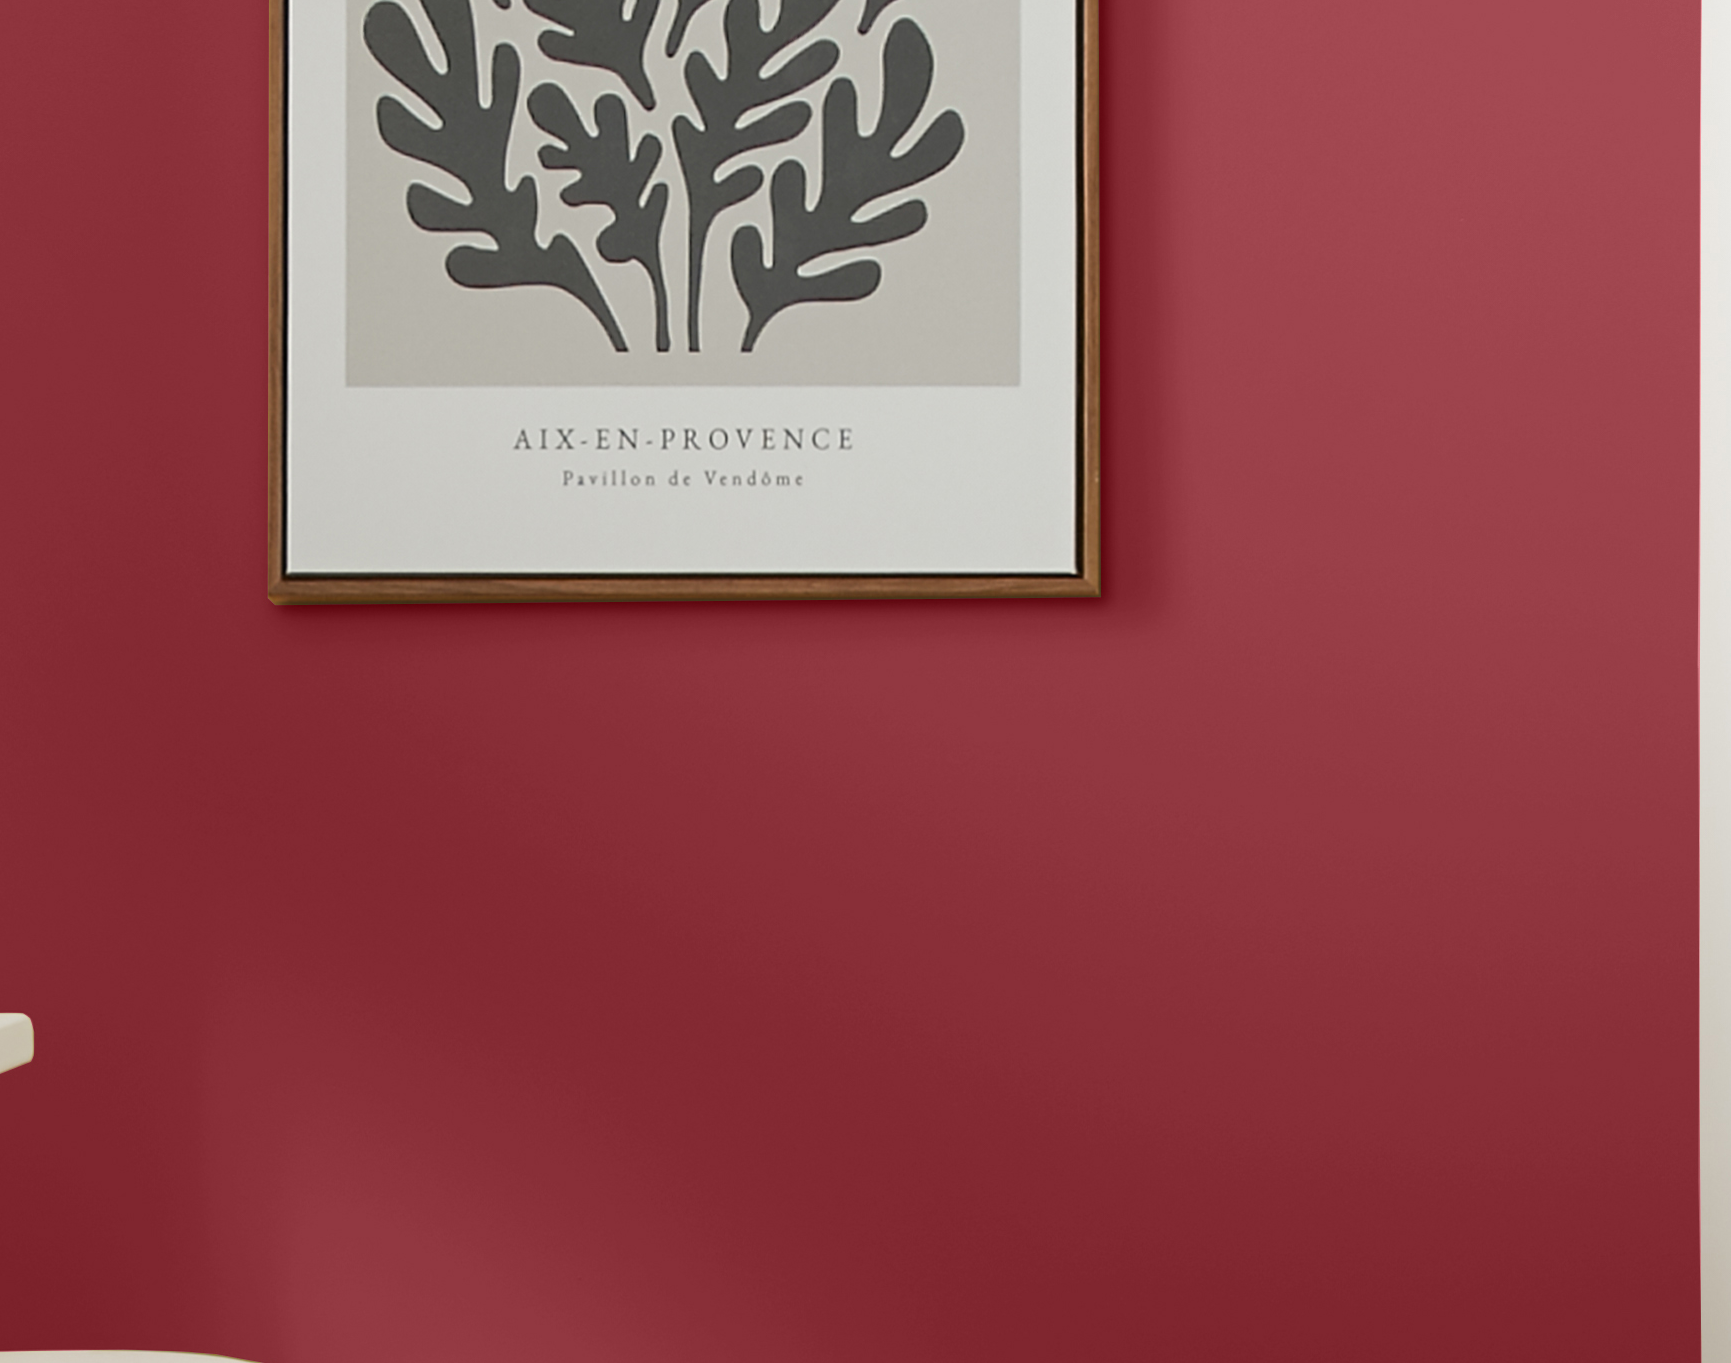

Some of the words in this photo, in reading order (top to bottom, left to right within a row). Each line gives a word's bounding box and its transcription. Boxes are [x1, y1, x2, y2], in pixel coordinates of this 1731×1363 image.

[513, 427, 853, 451] AIX-EN-PROVENCE
[562, 469, 656, 486] Pavillon
[668, 469, 691, 486] de
[704, 469, 803, 486] Vendôme
